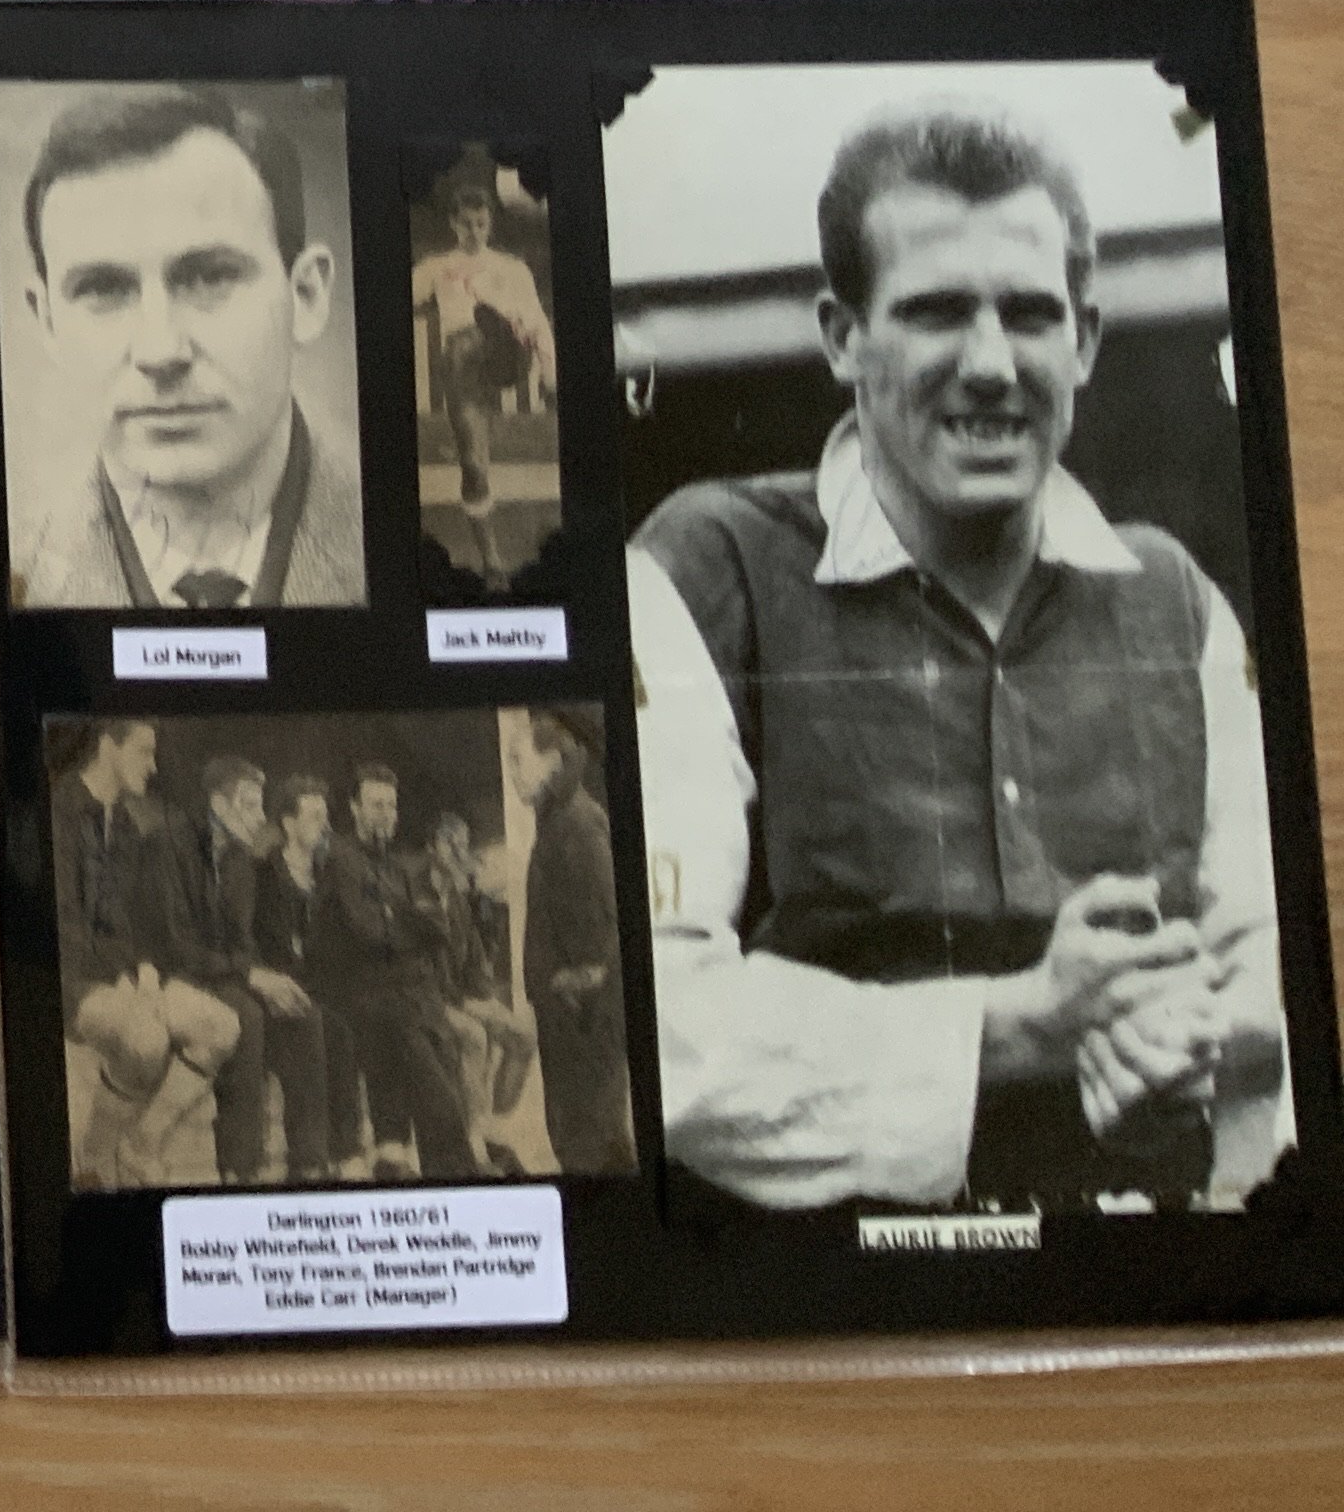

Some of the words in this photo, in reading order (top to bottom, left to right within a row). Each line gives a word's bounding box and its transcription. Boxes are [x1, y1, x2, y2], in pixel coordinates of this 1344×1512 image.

[442, 630, 480, 649] Jack
[486, 629, 546, 652] Maltby
[143, 645, 170, 666] Lol
[176, 646, 242, 670] Morgan
[267, 1210, 362, 1232] Darlington
[371, 1206, 451, 1228] 1960/61
[181, 1239, 238, 1259] Bobby
[347, 1235, 399, 1256] Derek
[406, 1233, 477, 1254] Weddle,
[484, 1232, 541, 1253] Jimmy
[250, 1263, 295, 1284] Tony
[374, 1260, 448, 1279] Brendan
[454, 1257, 536, 1278] Partridge
[265, 1291, 315, 1310] Eddie
[320, 1290, 357, 1307] Carr
[365, 1285, 457, 1307] (Manager)
